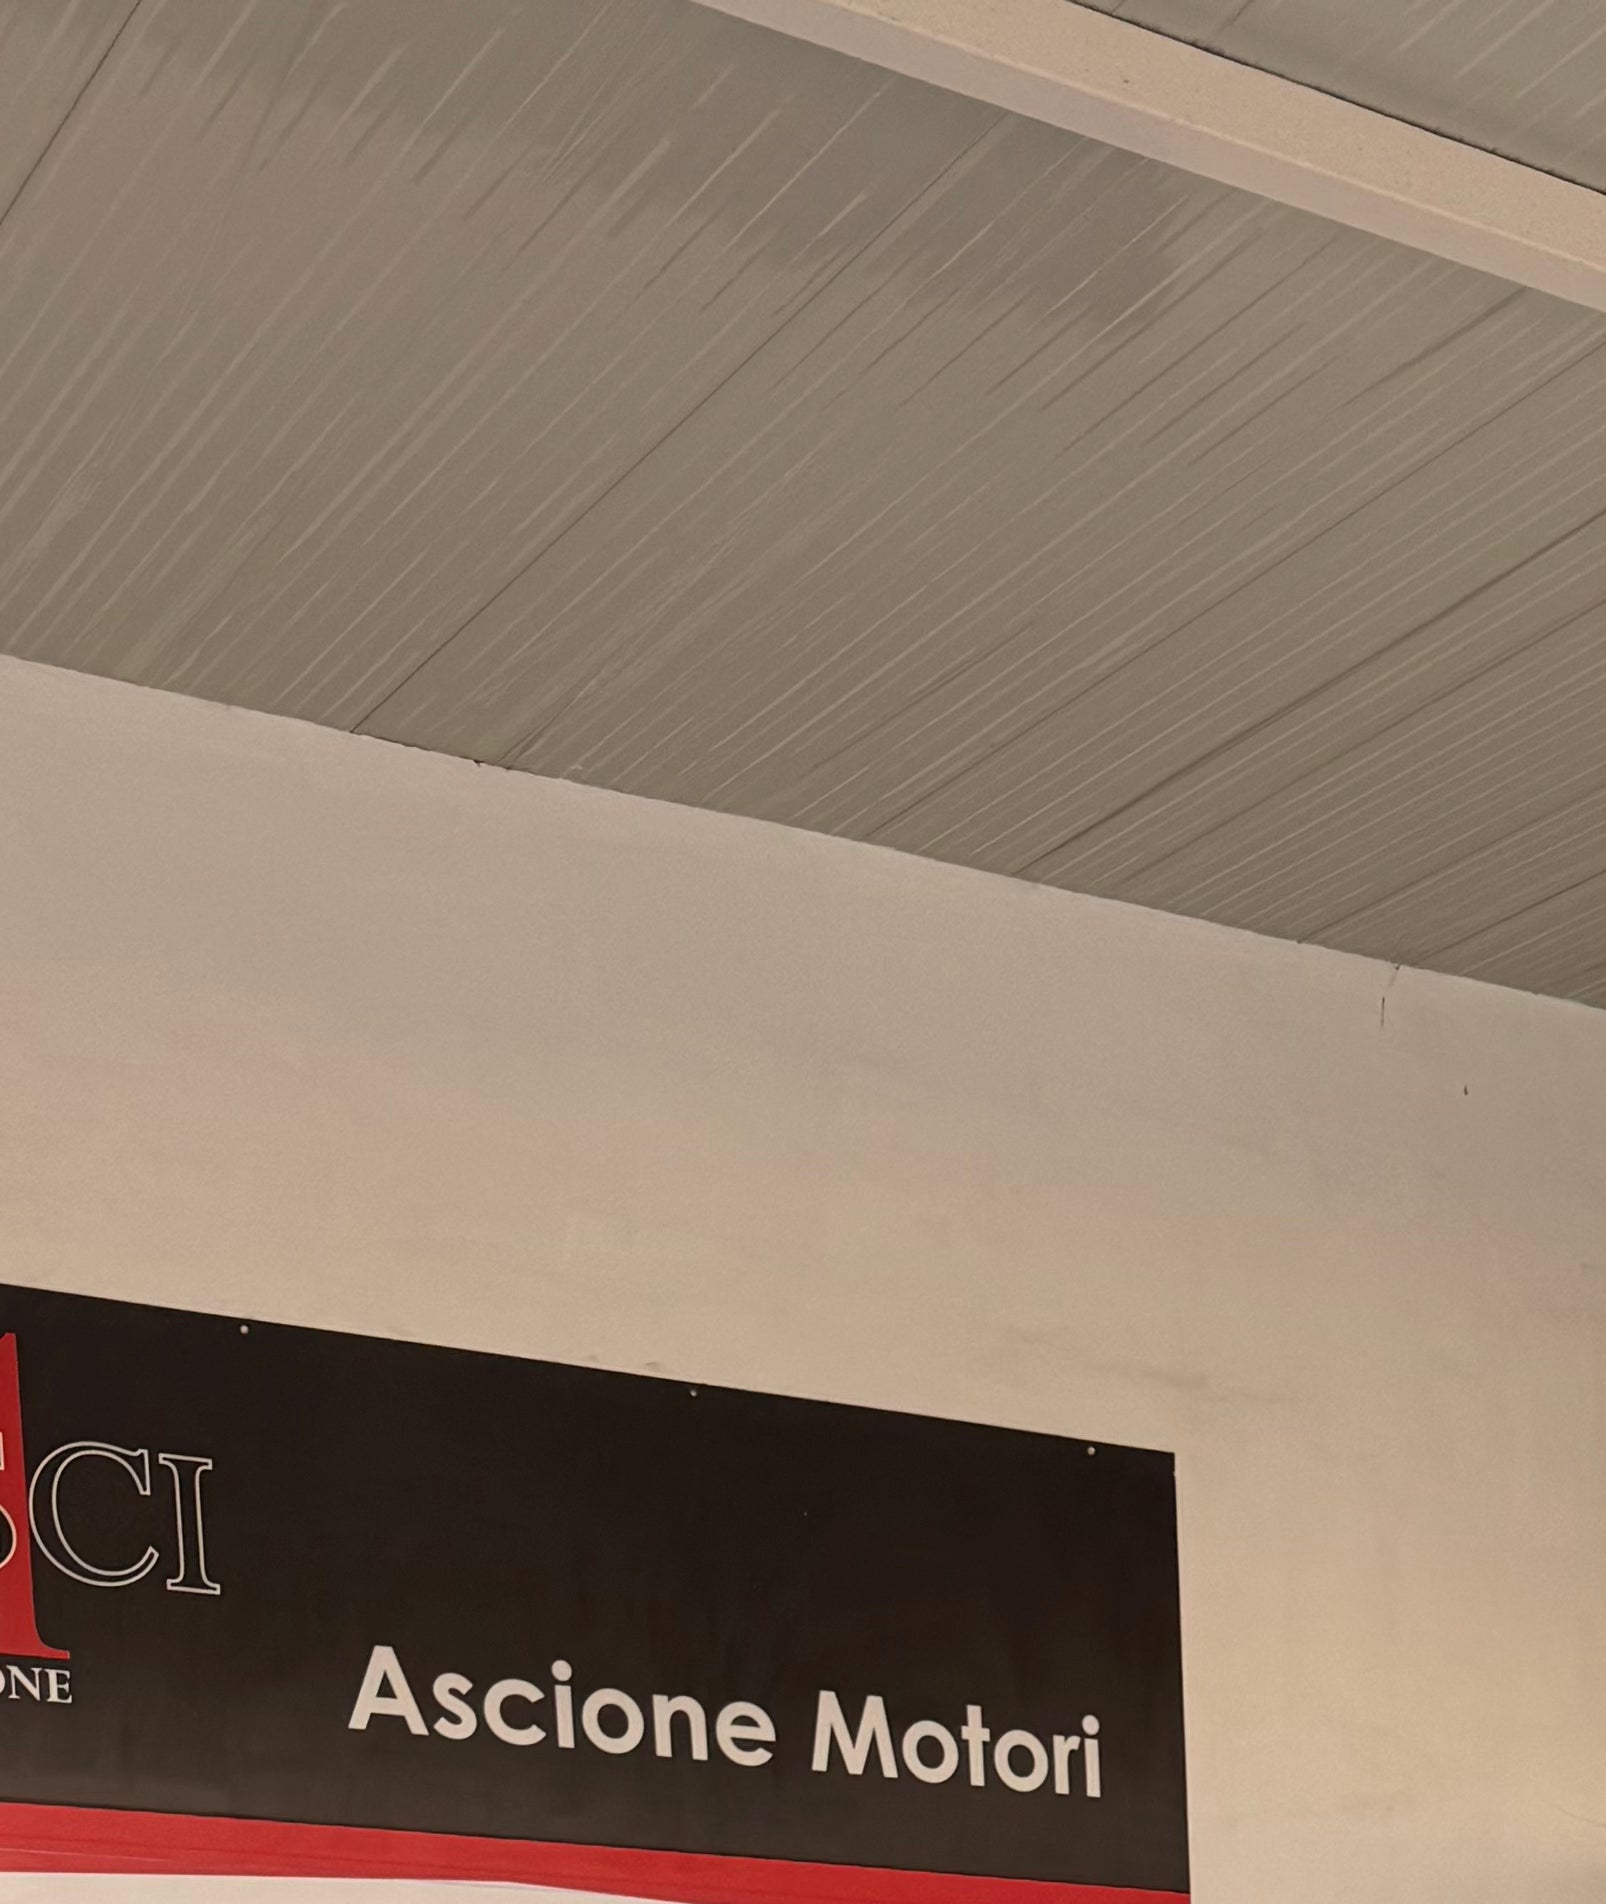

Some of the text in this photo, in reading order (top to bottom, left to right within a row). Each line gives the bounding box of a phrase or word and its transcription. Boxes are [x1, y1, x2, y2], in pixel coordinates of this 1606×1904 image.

[0, 1432, 221, 1596] CI
[0, 1663, 73, 1704] NE
[347, 1645, 1101, 1798] Ascione Motori
